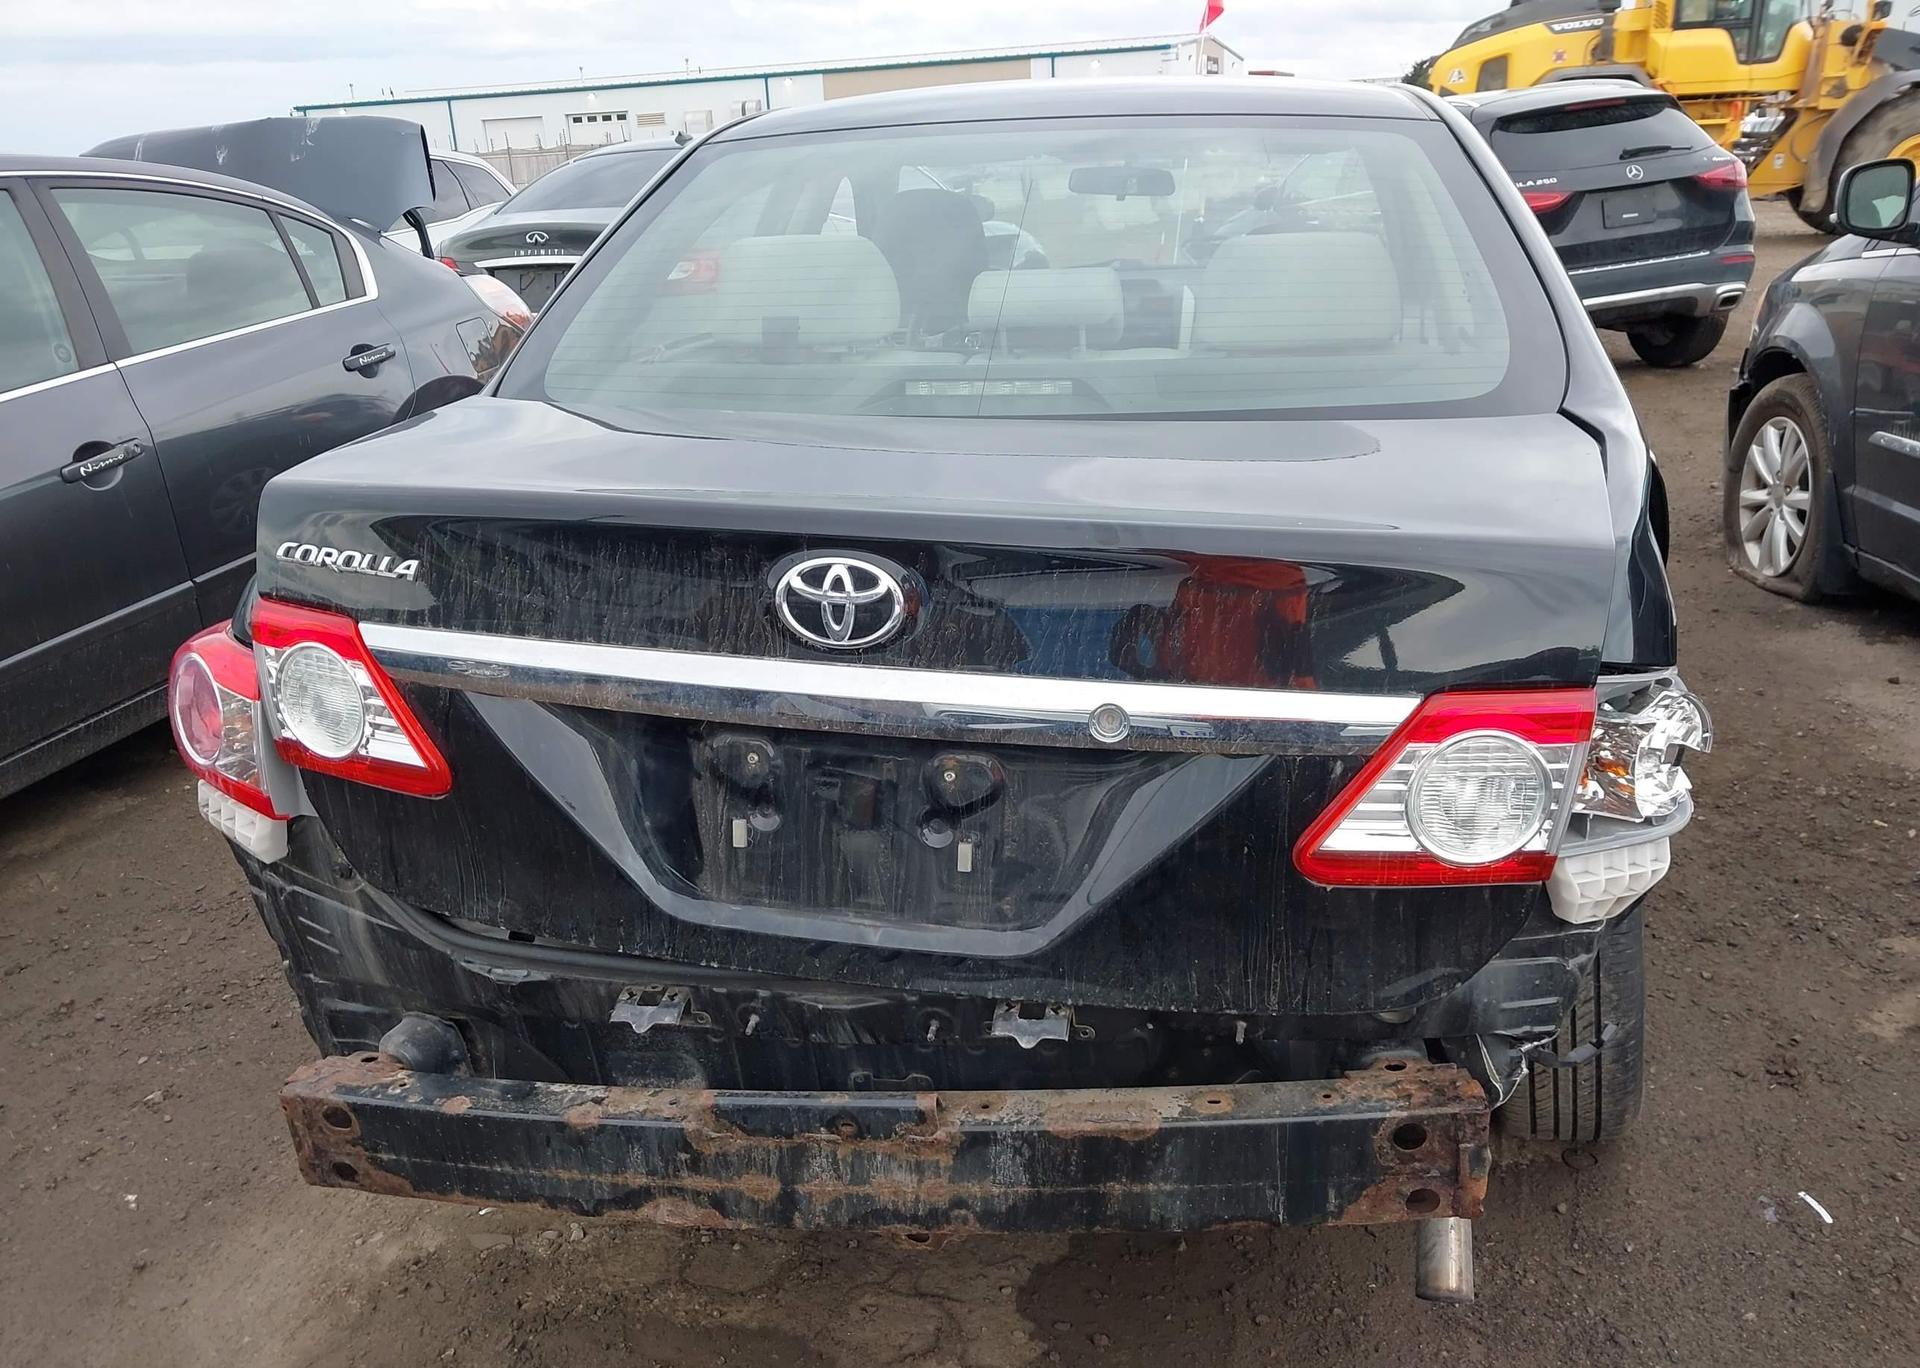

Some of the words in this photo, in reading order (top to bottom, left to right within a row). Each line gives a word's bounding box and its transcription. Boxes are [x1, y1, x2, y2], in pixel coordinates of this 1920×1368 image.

[1551, 18, 1604, 31] VOLVO
[514, 248, 564, 256] INFINITI
[80, 454, 124, 476] Nismo
[276, 541, 420, 581] COROLLA
